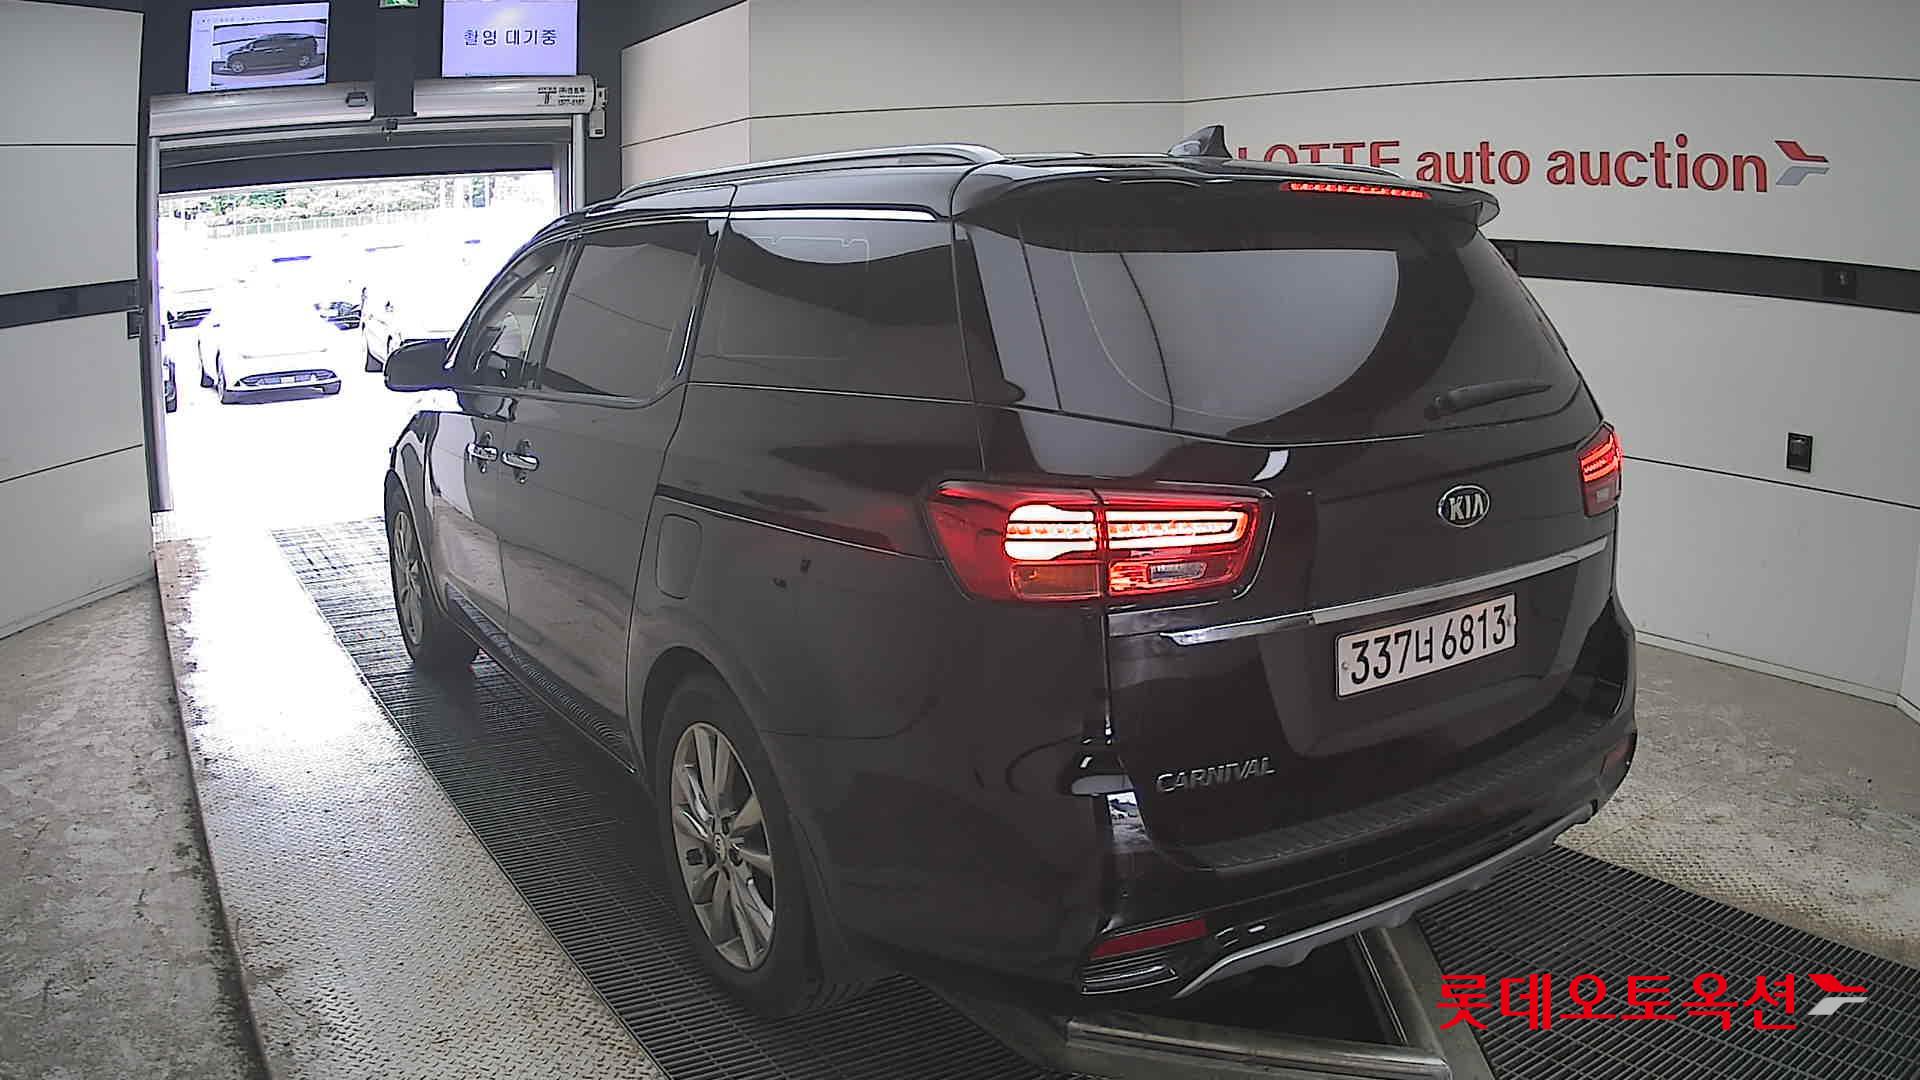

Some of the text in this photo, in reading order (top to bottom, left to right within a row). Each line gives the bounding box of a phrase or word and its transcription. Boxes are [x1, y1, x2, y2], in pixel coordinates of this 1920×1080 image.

[505, 29, 557, 46] 대기중
[1416, 141, 1531, 185] auto
[1546, 133, 1768, 192] auction
[1448, 492, 1485, 521] KIA
[1156, 755, 1276, 793] CARNIVAL
